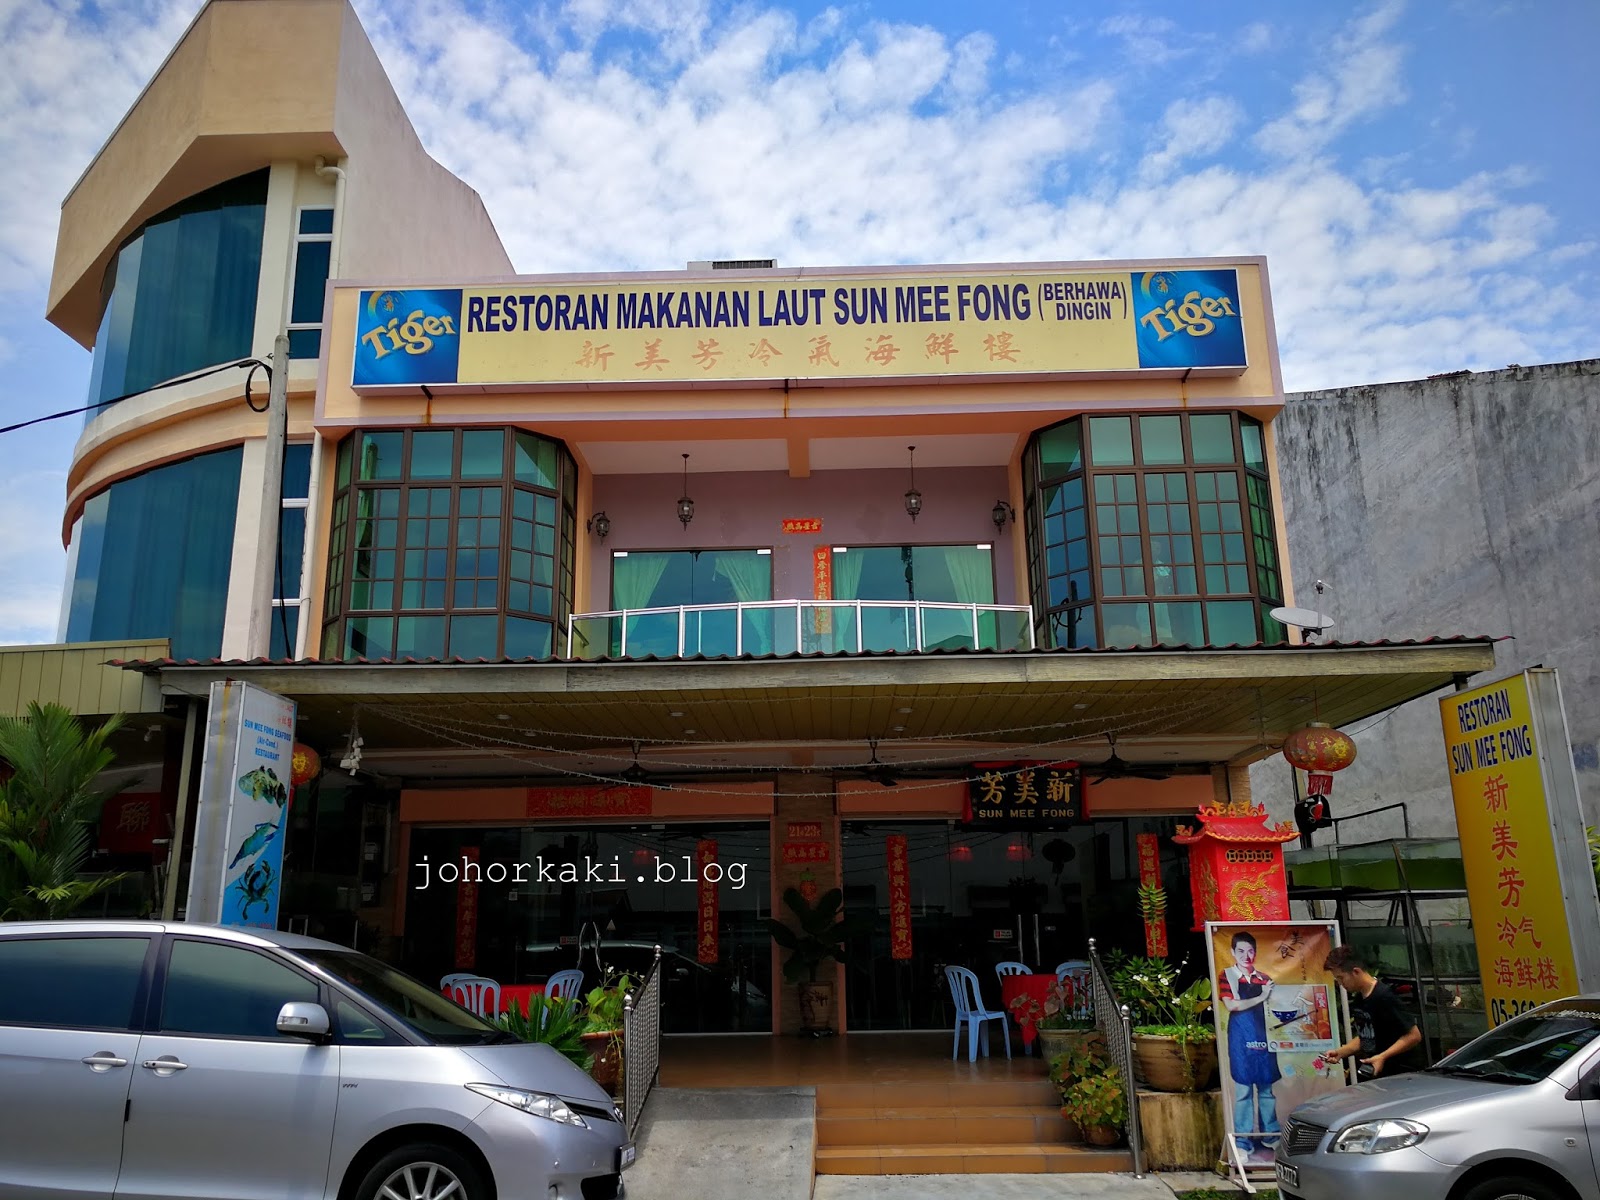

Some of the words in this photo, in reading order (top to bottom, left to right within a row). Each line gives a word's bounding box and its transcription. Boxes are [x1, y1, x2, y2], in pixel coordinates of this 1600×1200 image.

[467, 291, 608, 333] RESTORAN
[616, 290, 751, 330] MAKANAN
[758, 288, 827, 327] LAUT
[833, 286, 888, 326] SUN
[896, 285, 952, 324] MEE
[958, 283, 1031, 322] FONG
[1140, 289, 1237, 342] Tiger
[361, 308, 457, 361] Tiger
[1457, 688, 1512, 734] RESTORAN
[1451, 744, 1473, 775] SUN
[1475, 735, 1499, 770] MEE
[1500, 723, 1533, 762] FONG
[978, 809, 1003, 818] SUN
[1009, 809, 1035, 818] MEE
[1041, 809, 1075, 818] FONG
[1482, 773, 1525, 909] 新美芳
[1496, 915, 1542, 950] 冷气
[1493, 956, 1560, 992] 海鲜楼
[1246, 1040, 1267, 1049] astro
